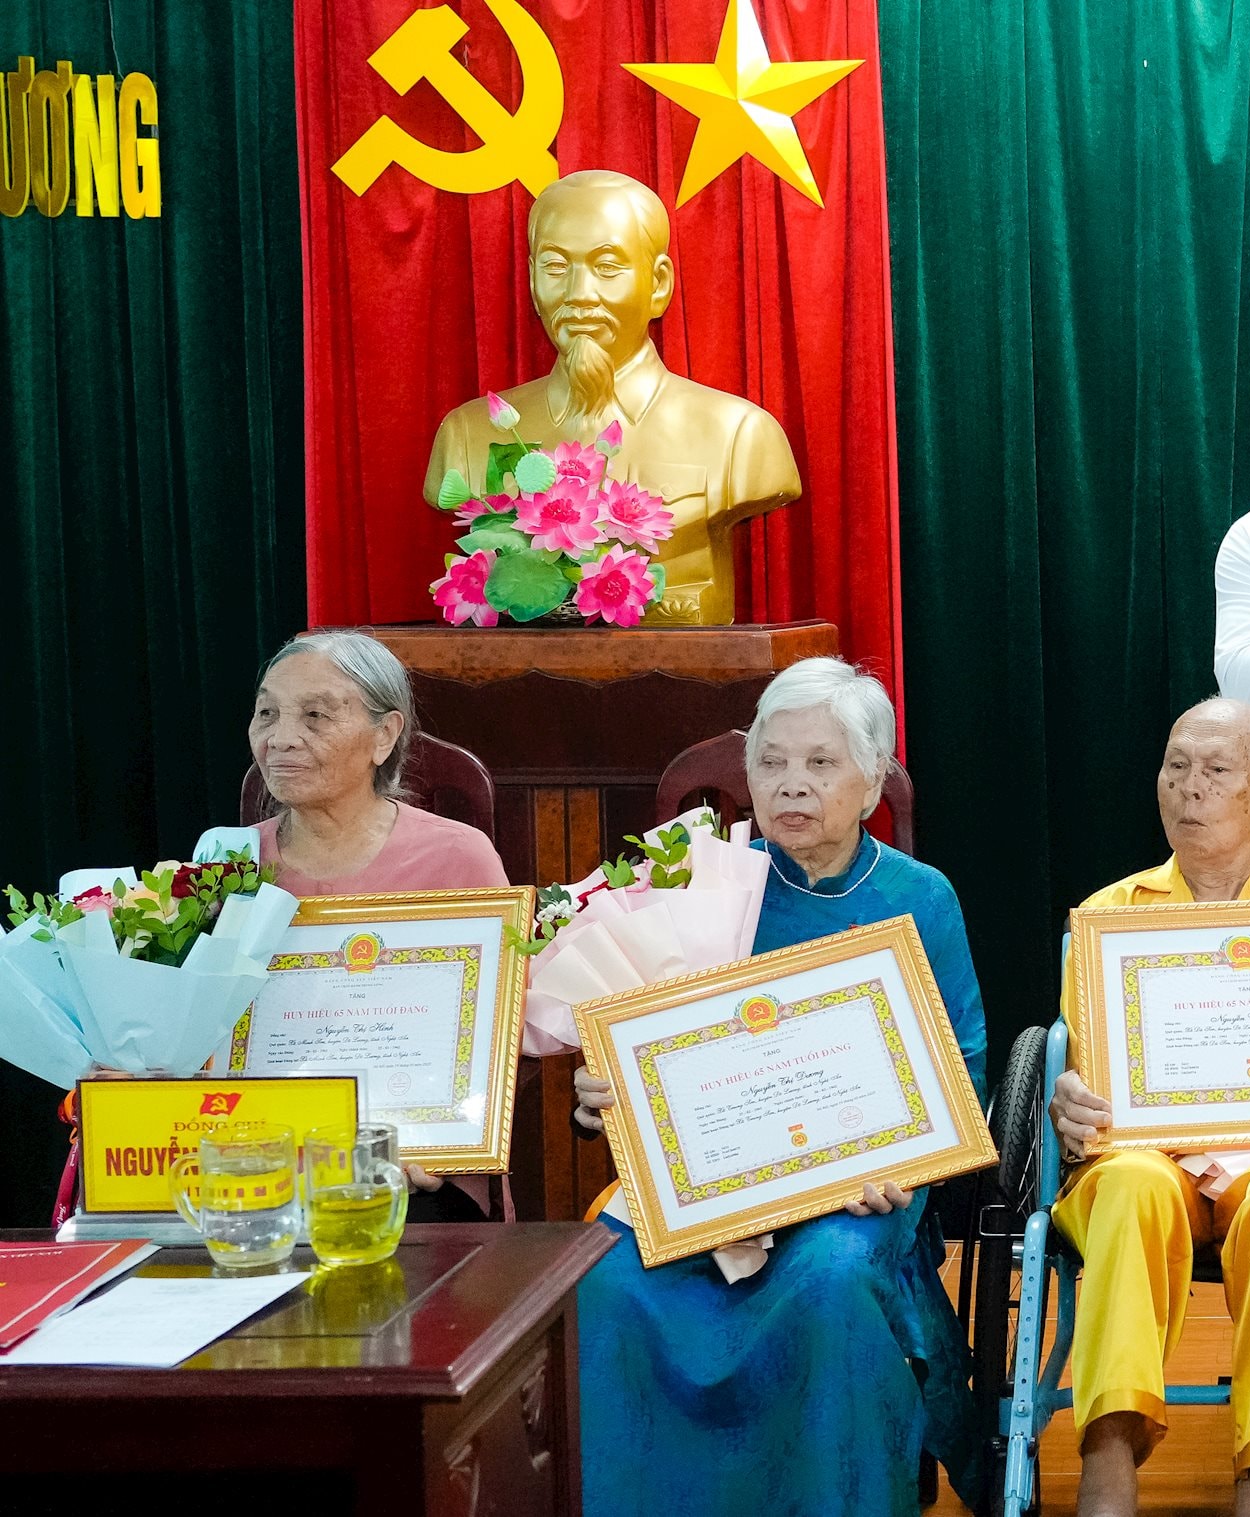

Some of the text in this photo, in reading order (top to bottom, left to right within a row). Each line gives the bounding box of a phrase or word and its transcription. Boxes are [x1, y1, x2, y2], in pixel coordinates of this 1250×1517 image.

[1174, 1002, 1195, 1010] HUY
[283, 1011, 304, 1020] HUY
[334, 1009, 344, 1017] 65
[700, 1079, 723, 1092] HUY
[754, 1067, 765, 1076] 65
